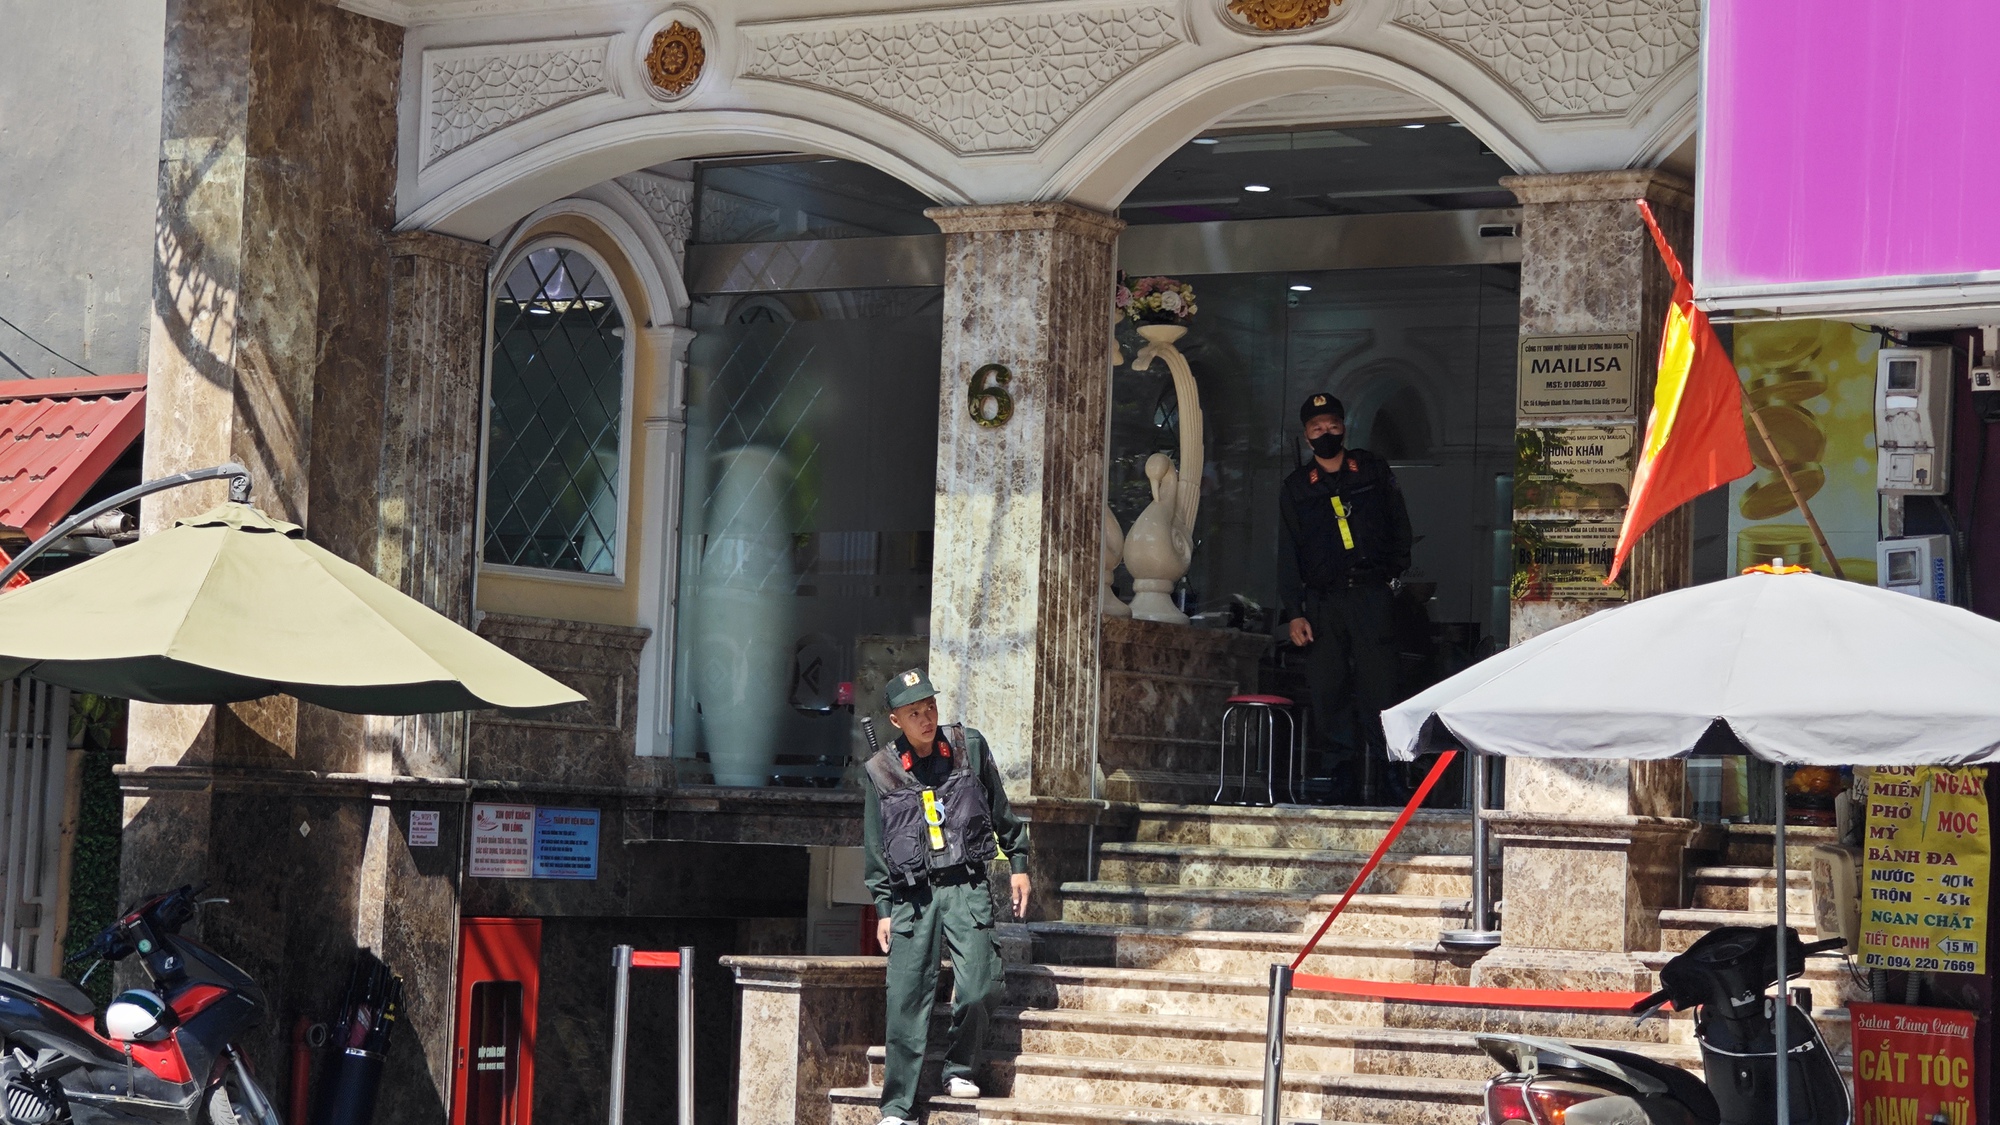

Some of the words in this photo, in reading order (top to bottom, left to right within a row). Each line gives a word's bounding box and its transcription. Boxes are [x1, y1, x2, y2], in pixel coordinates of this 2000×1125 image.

[1531, 357, 1621, 374] MAILISA
[1546, 381, 1562, 389] MST:
[968, 363, 1014, 428] 6
[1576, 443, 1604, 456] KHÁM
[1534, 548, 1555, 564] CHU
[1557, 547, 1585, 564] MINH
[1588, 541, 1616, 565] THẮN
[1873, 780, 1922, 798] MIẾN
[1934, 772, 1984, 797] NGAN
[1871, 802, 1913, 820] PHỞ
[1937, 811, 1979, 838] MỌC
[1869, 824, 1899, 840] MỲ
[1868, 845, 1921, 864] BÁNH
[1926, 851, 1958, 866] ĐA
[1871, 868, 1915, 884] NƯỚC
[1871, 887, 1912, 904] TRỘN
[1871, 909, 1919, 926] NGAN
[1924, 912, 1974, 931] CHẶT
[1865, 930, 1888, 946] TIẾT
[1891, 935, 1930, 949] CANH
[1946, 941, 1959, 951] 15
[1963, 943, 1974, 953] M
[1866, 953, 1884, 966] ĐT:
[1887, 956, 1911, 968] 094
[1915, 958, 1939, 970] 220
[1943, 960, 1975, 972] 7669
[1858, 1013, 1890, 1029] Salon
[1860, 1039, 1909, 1083] CẮT
[1918, 1049, 1969, 1088] TÓC
[1875, 1096, 1919, 1125] NAM
